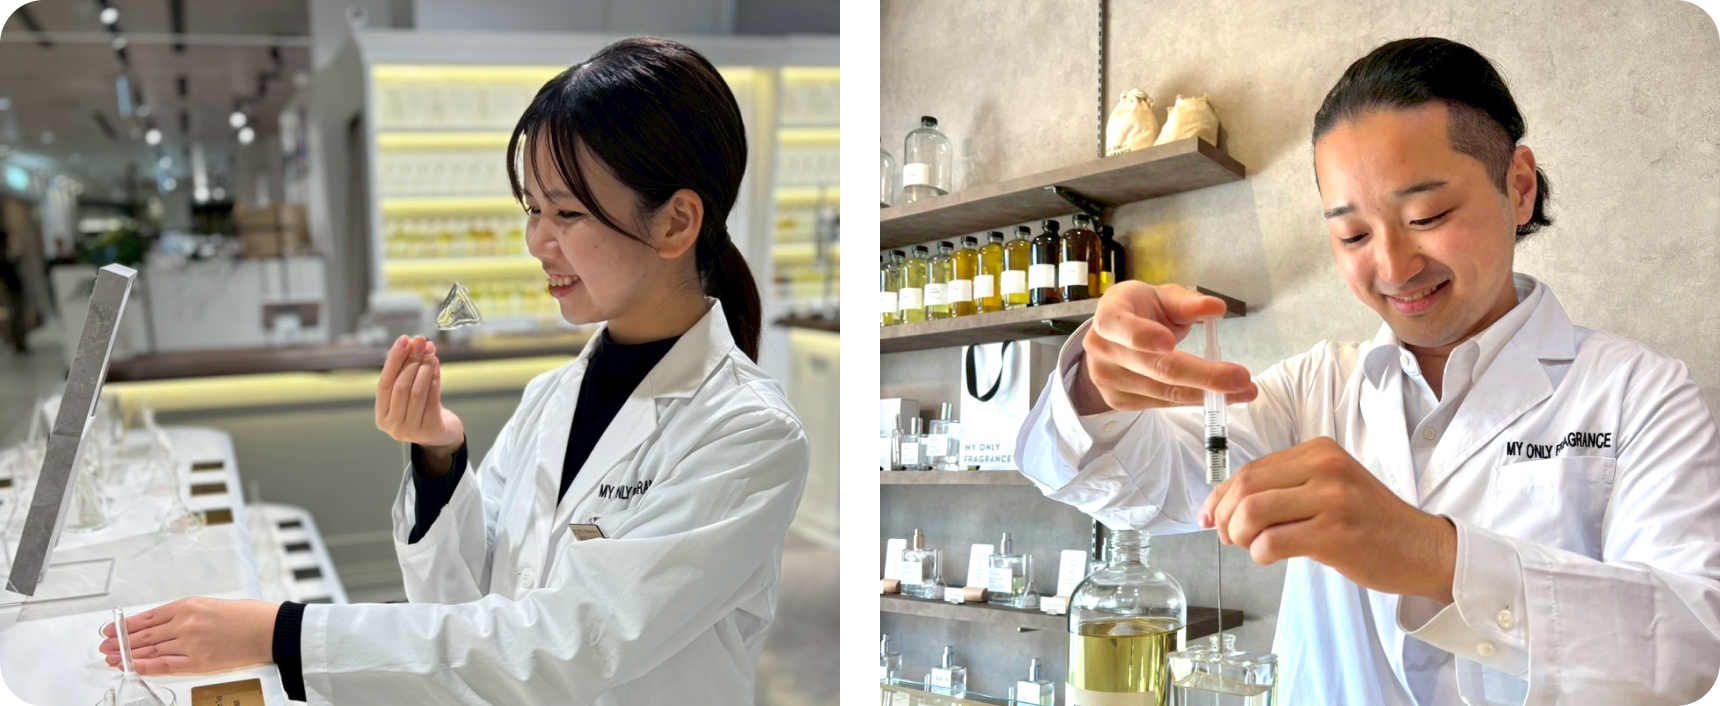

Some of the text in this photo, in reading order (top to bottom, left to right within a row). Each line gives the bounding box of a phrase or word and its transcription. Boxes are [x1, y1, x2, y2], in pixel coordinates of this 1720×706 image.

[979, 443, 1001, 451] ONLY
[1506, 441, 1523, 456] MY
[1526, 443, 1553, 459] ONLY
[964, 455, 1011, 463] FRAGRANCE
[598, 483, 615, 499] MY
[614, 485, 633, 500] NLY
